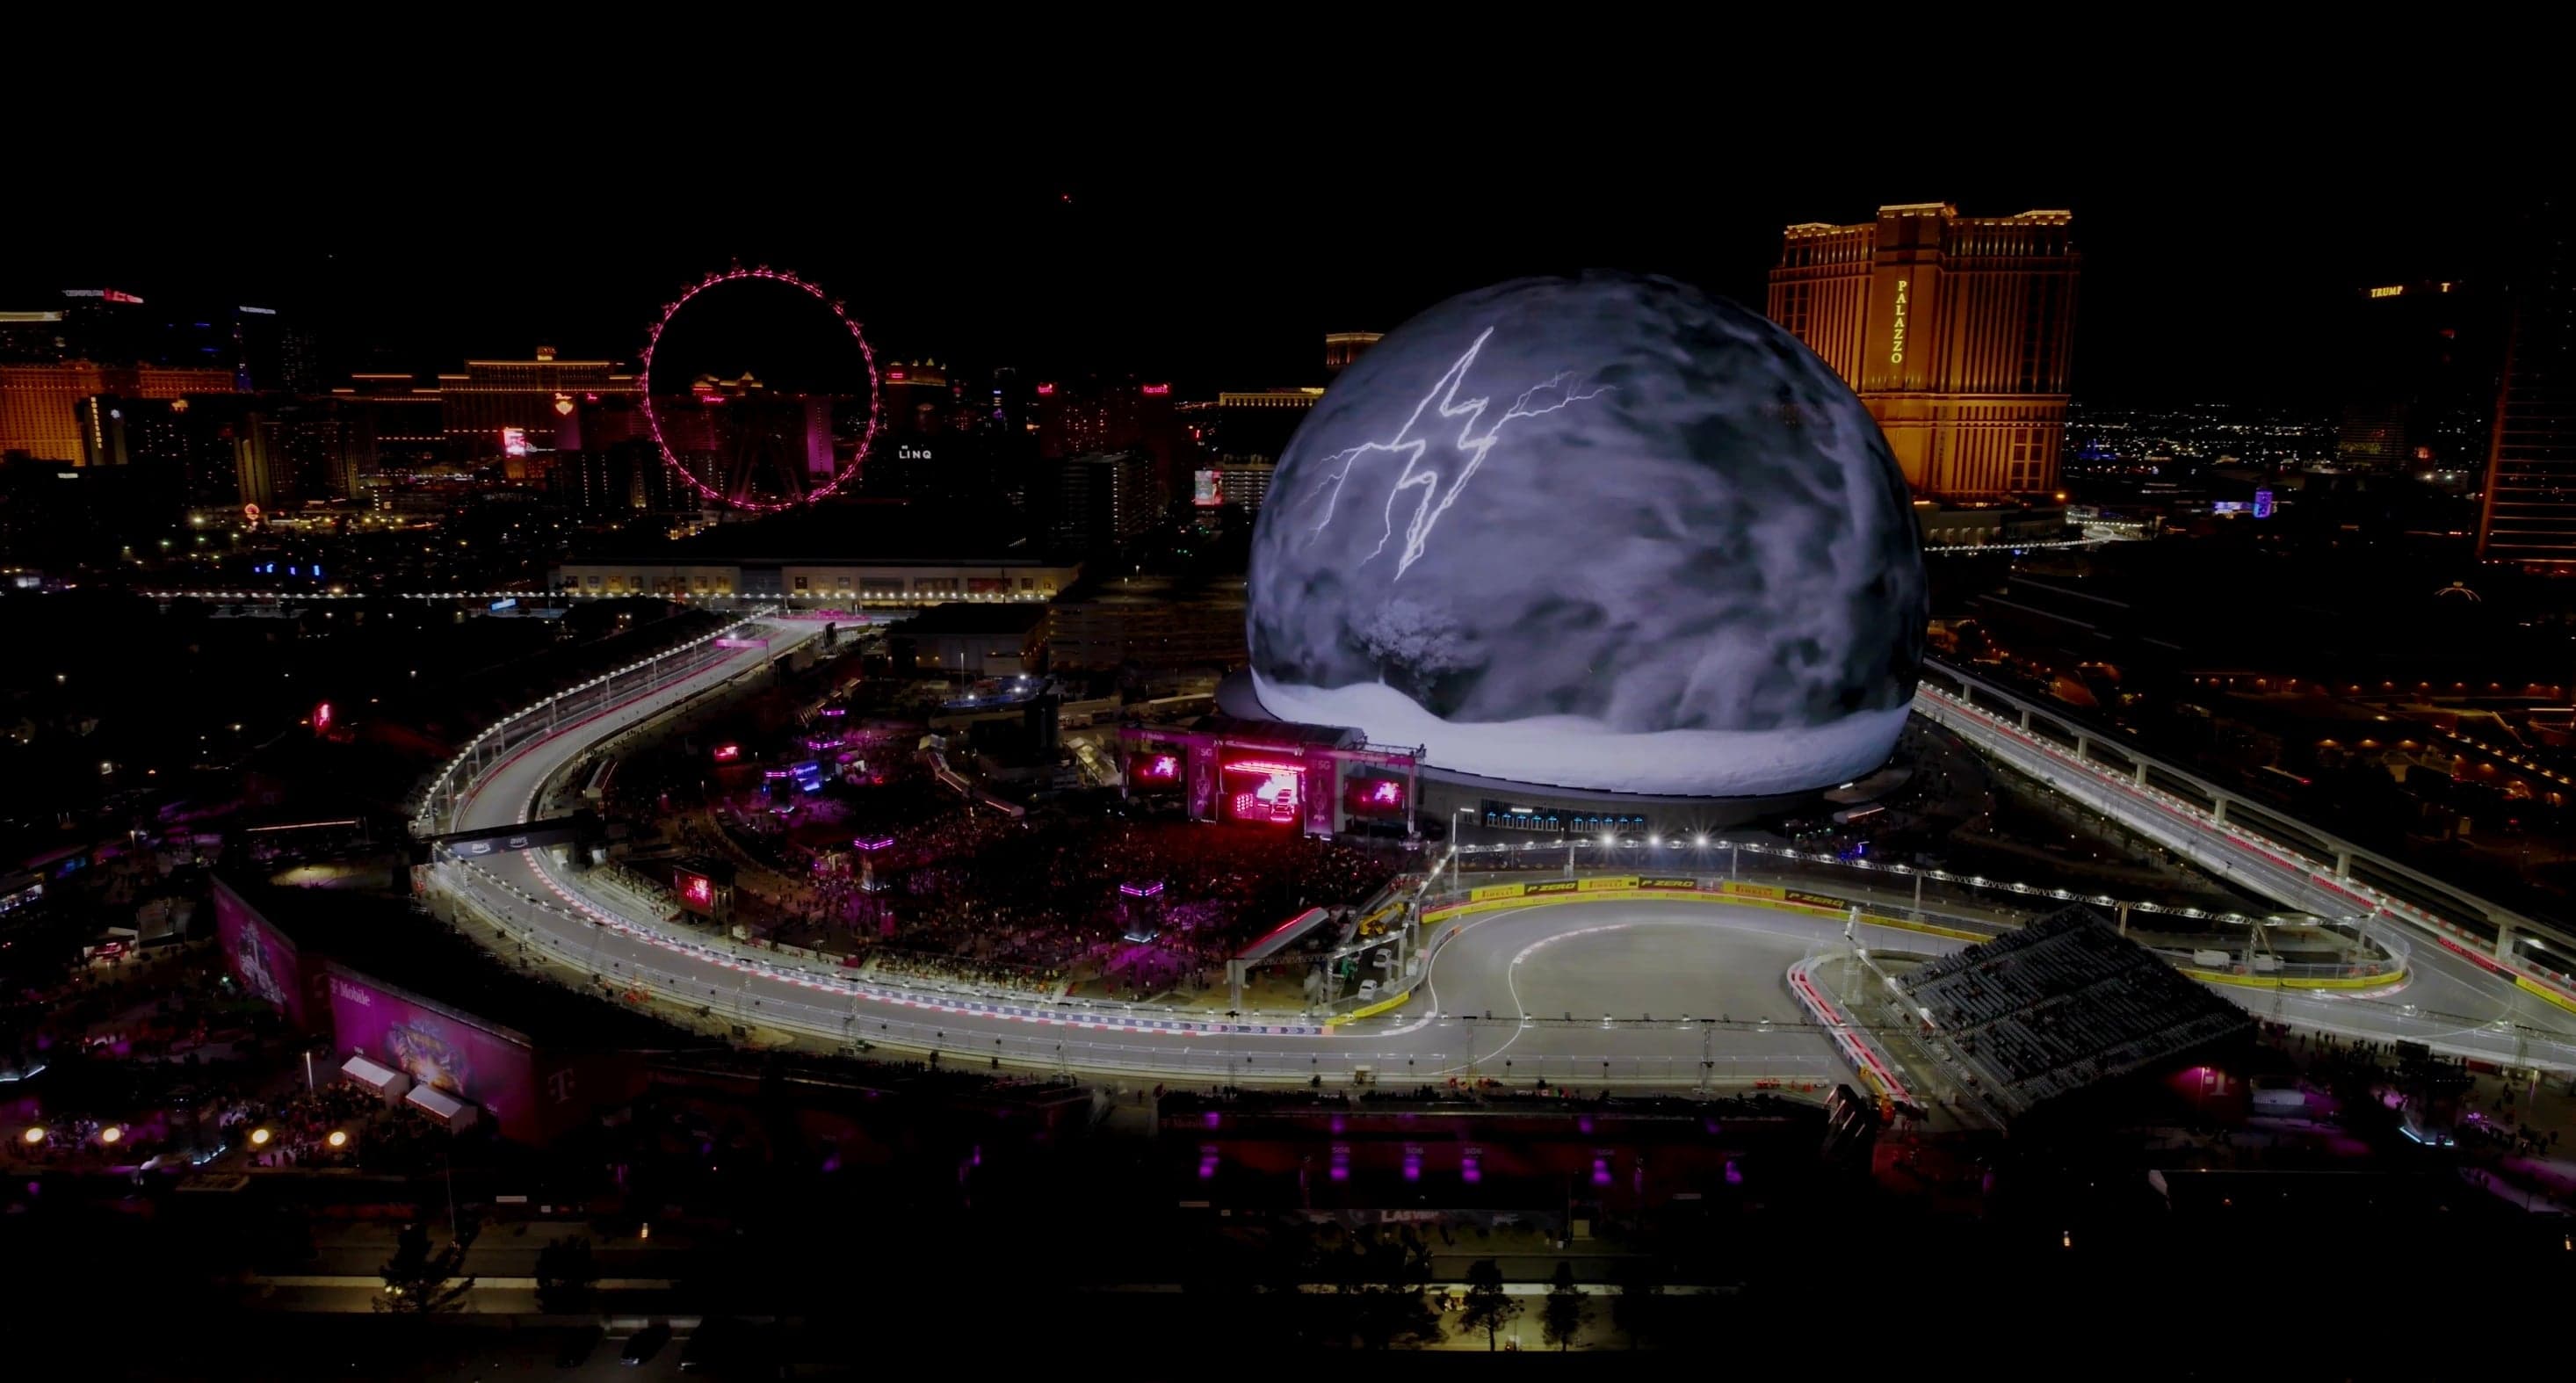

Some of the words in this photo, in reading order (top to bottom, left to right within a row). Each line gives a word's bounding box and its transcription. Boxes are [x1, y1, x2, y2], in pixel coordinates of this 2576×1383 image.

[2370, 286, 2404, 298] TRUMP
[2441, 282, 2451, 293] T
[1891, 280, 1907, 364] PALAZZO
[899, 450, 932, 460] LINQ
[1539, 883, 1576, 892] ZERO
[340, 981, 371, 1007] Mobile
